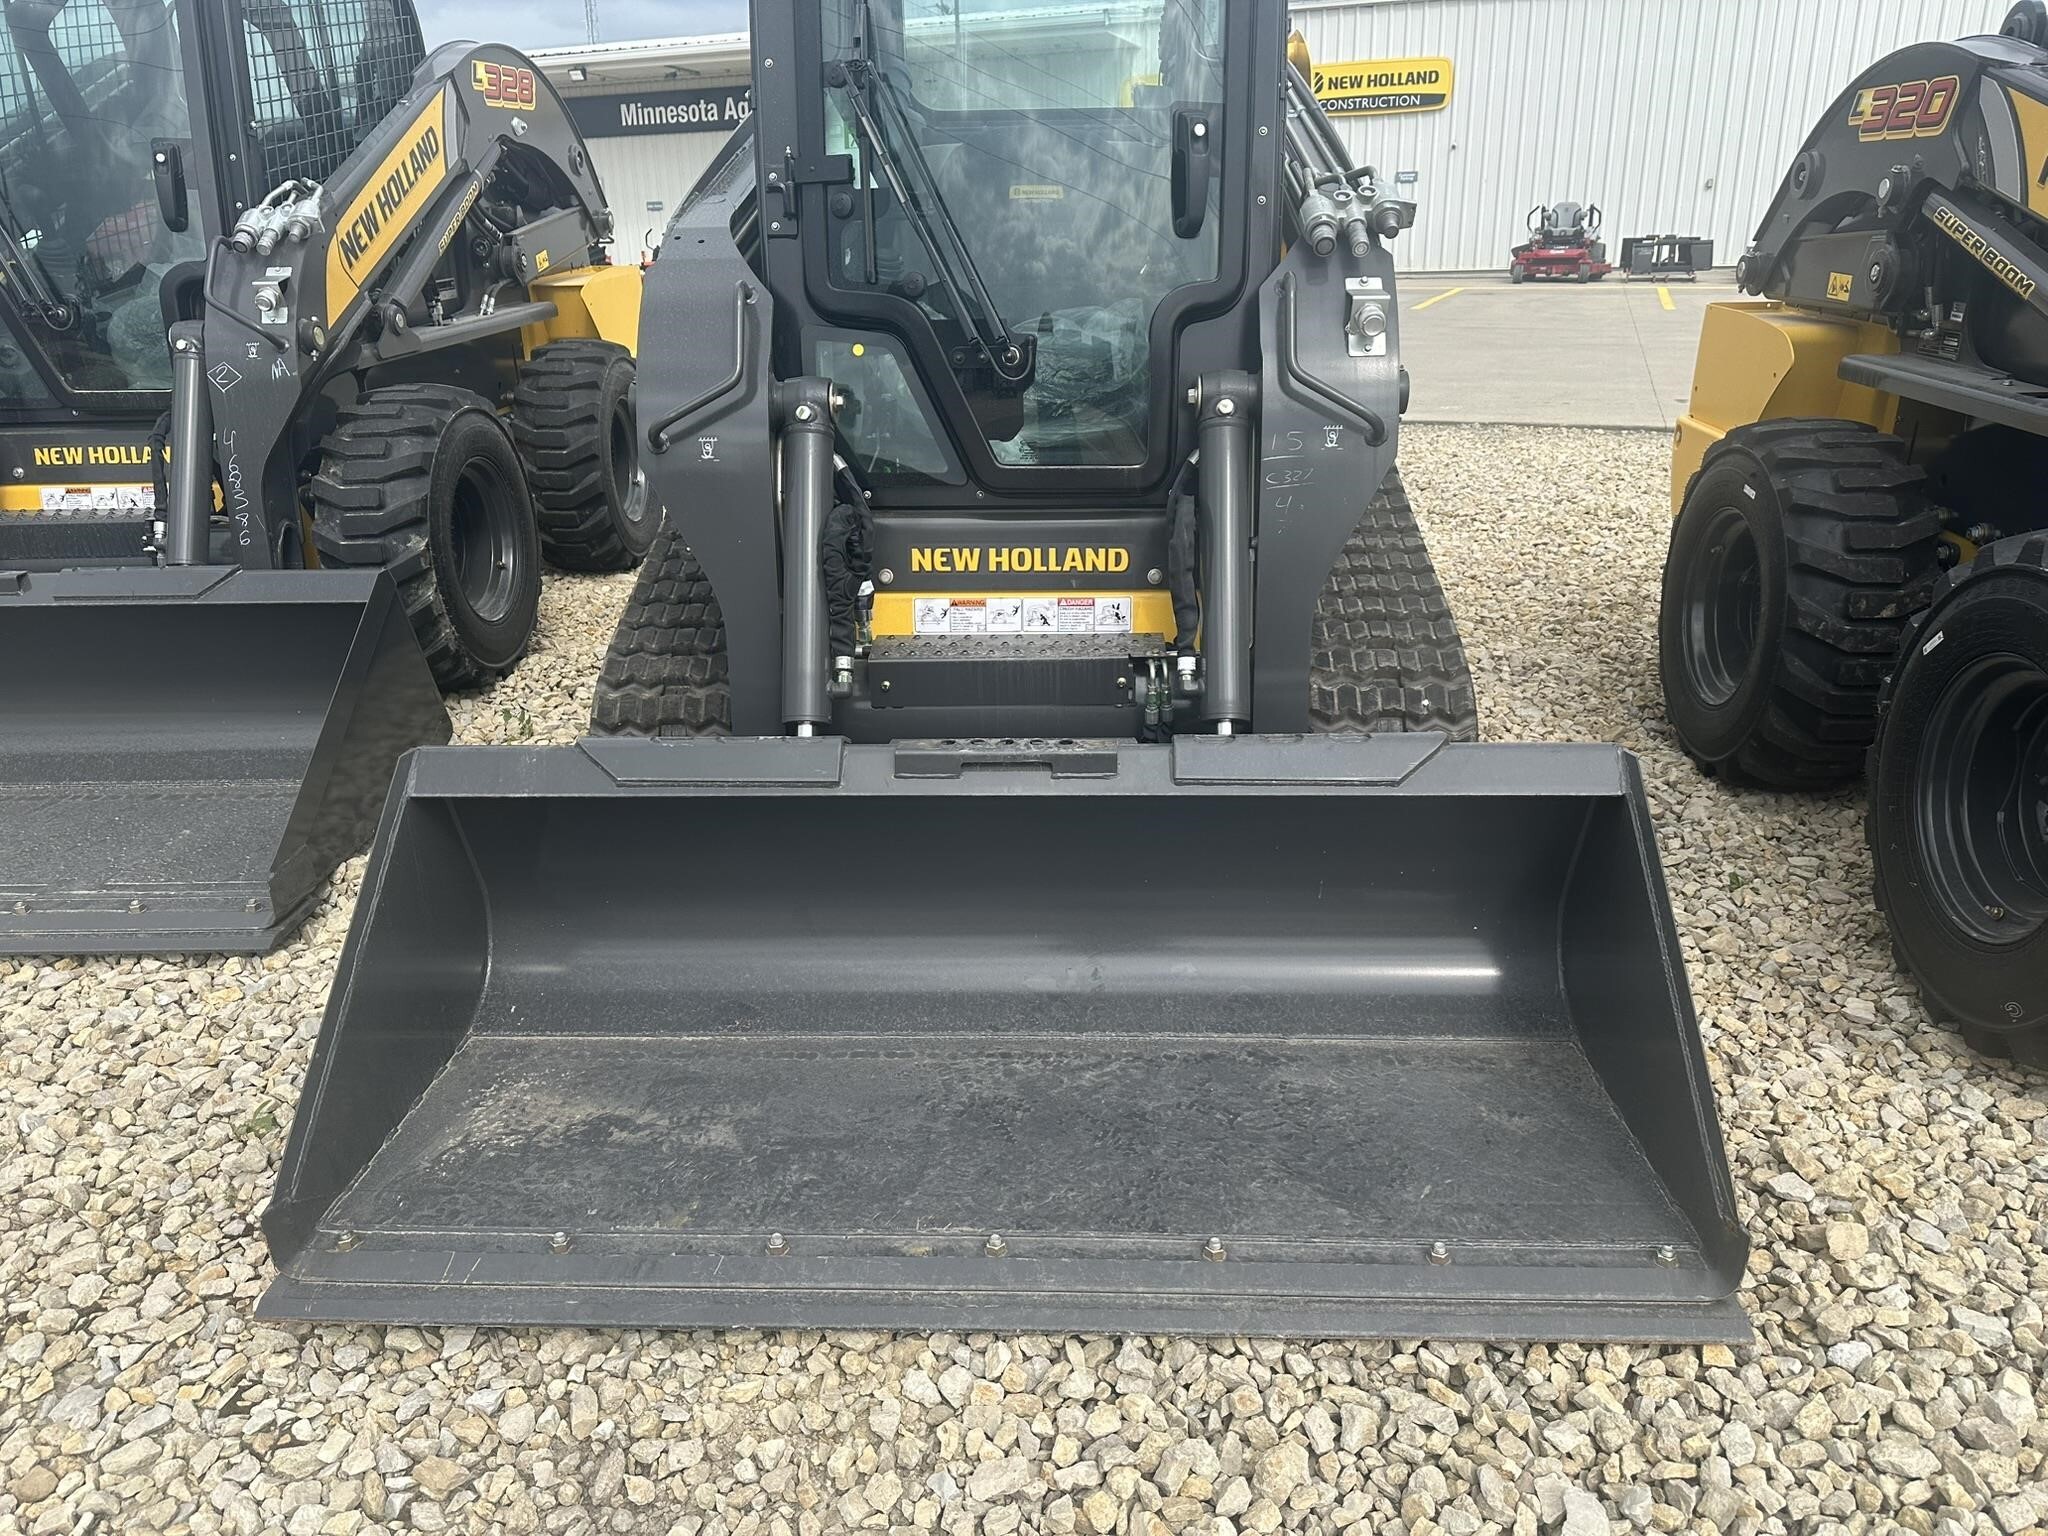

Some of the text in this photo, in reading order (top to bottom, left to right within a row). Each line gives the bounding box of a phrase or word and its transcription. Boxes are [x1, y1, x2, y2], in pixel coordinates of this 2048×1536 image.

[472, 60, 536, 111] L328
[1328, 70, 1440, 90] NEW HOLLAND
[620, 99, 718, 126] Minnesota
[1320, 95, 1421, 111] CONSTRUCTION
[1848, 75, 1960, 142] L320
[339, 125, 440, 269] NEW HOLLAND
[34, 447, 83, 465] NEW
[911, 547, 1130, 572] NEW HOLLAND
